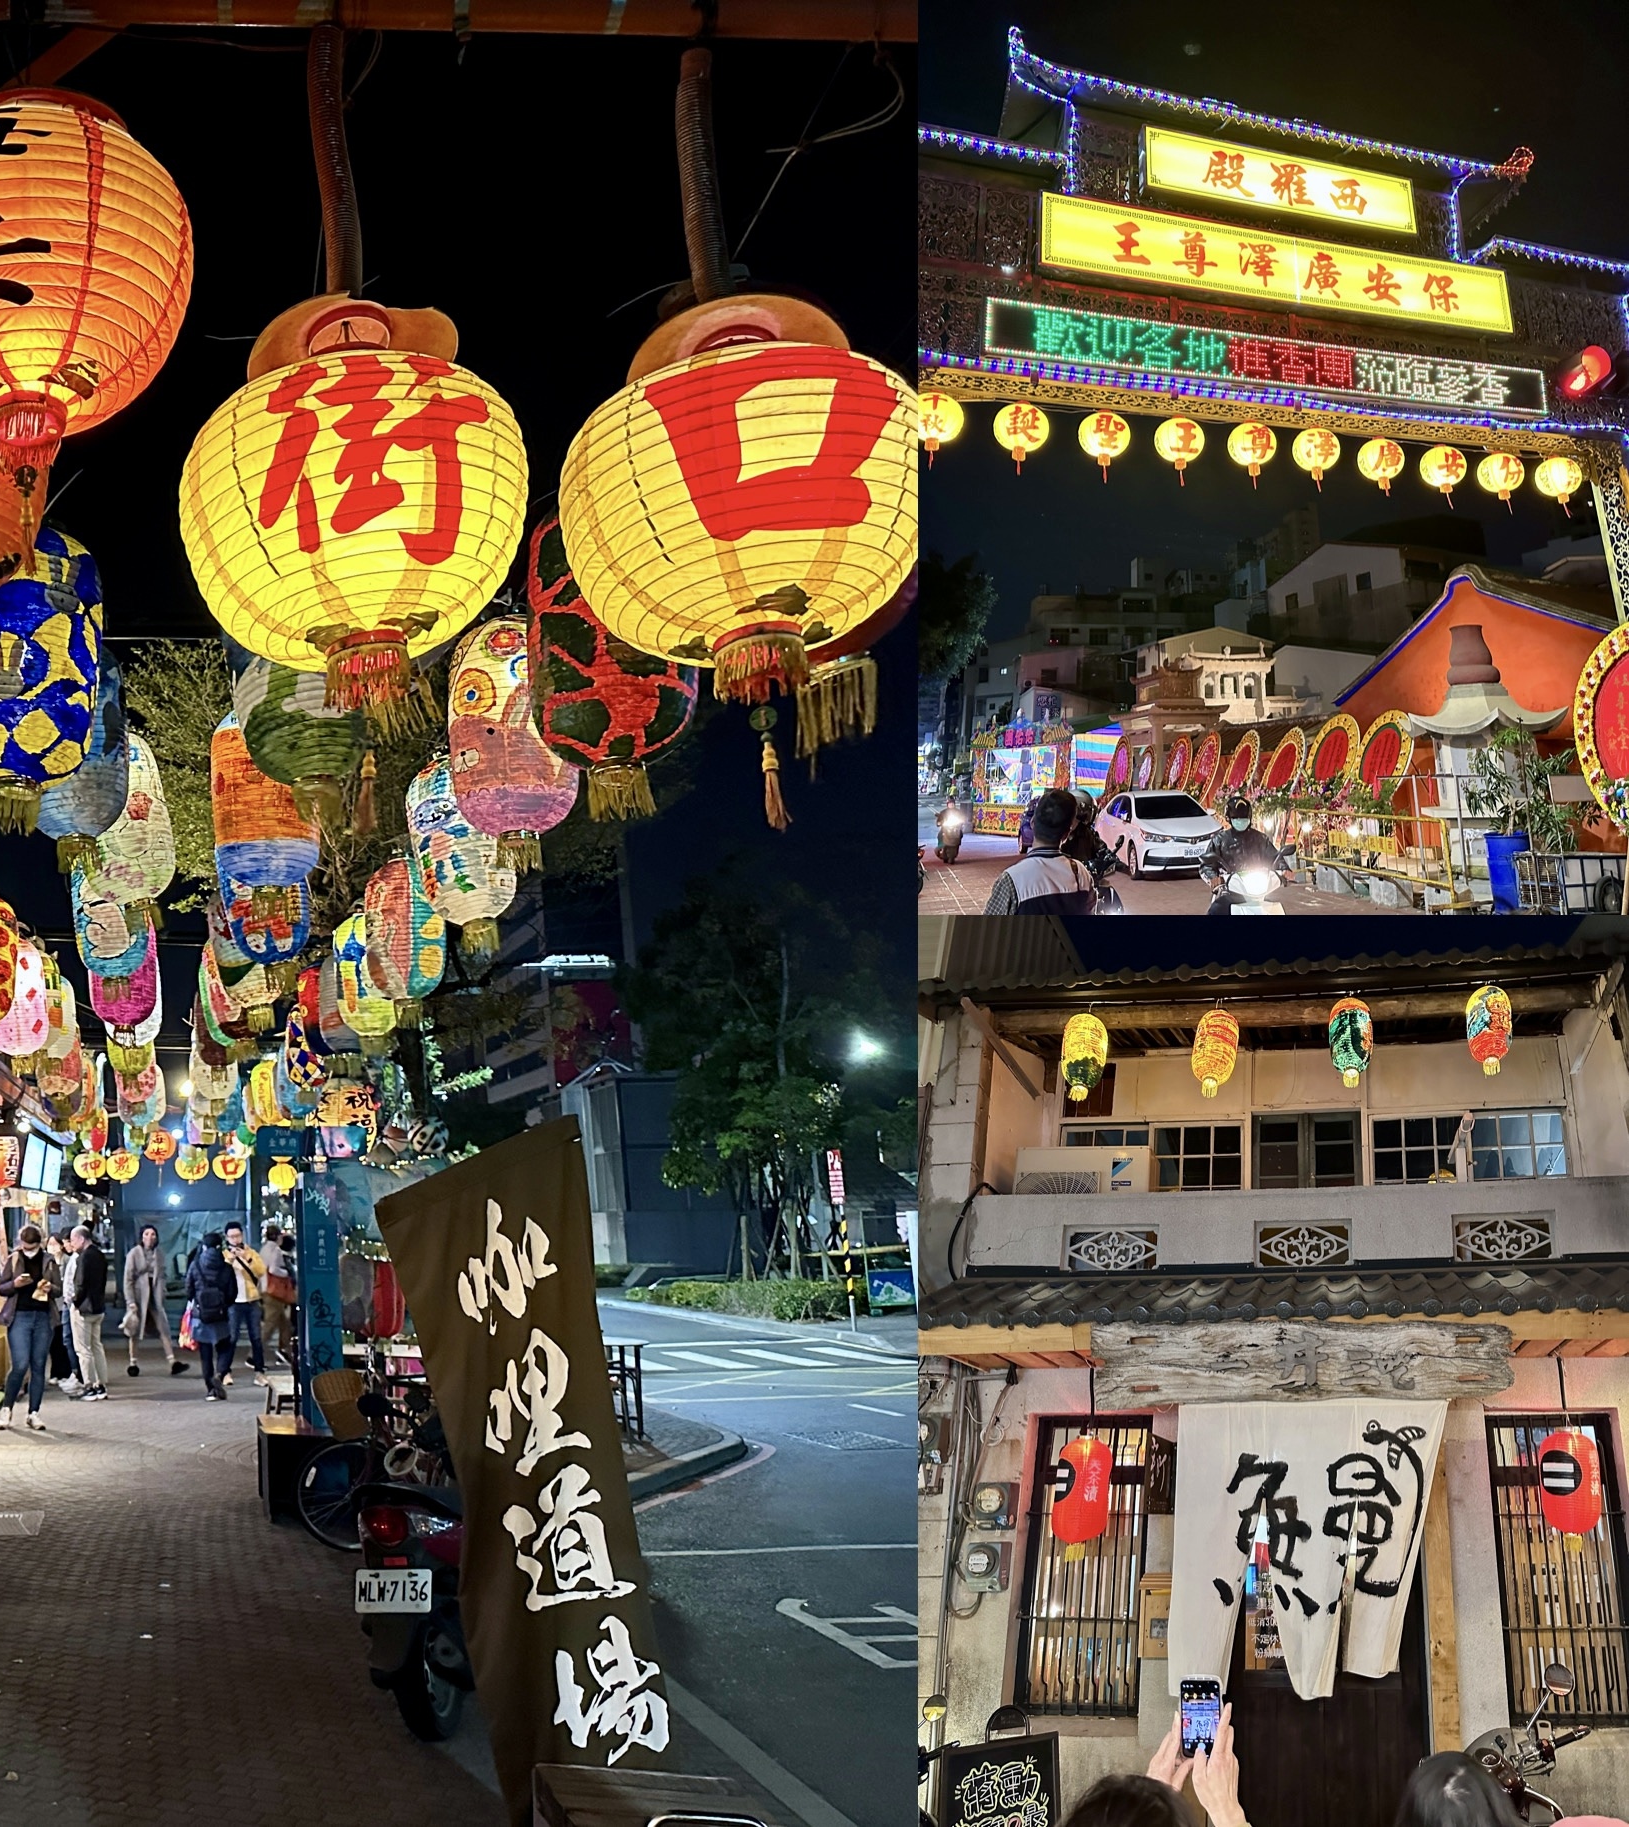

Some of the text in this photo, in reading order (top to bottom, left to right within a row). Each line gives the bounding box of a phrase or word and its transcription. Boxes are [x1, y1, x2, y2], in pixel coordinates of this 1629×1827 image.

[1202, 150, 1368, 217] 西羅殿
[258, 354, 489, 566] 街
[643, 345, 901, 541] 口
[1169, 421, 1200, 455] 王
[457, 1198, 670, 1767] 咖哩道場
